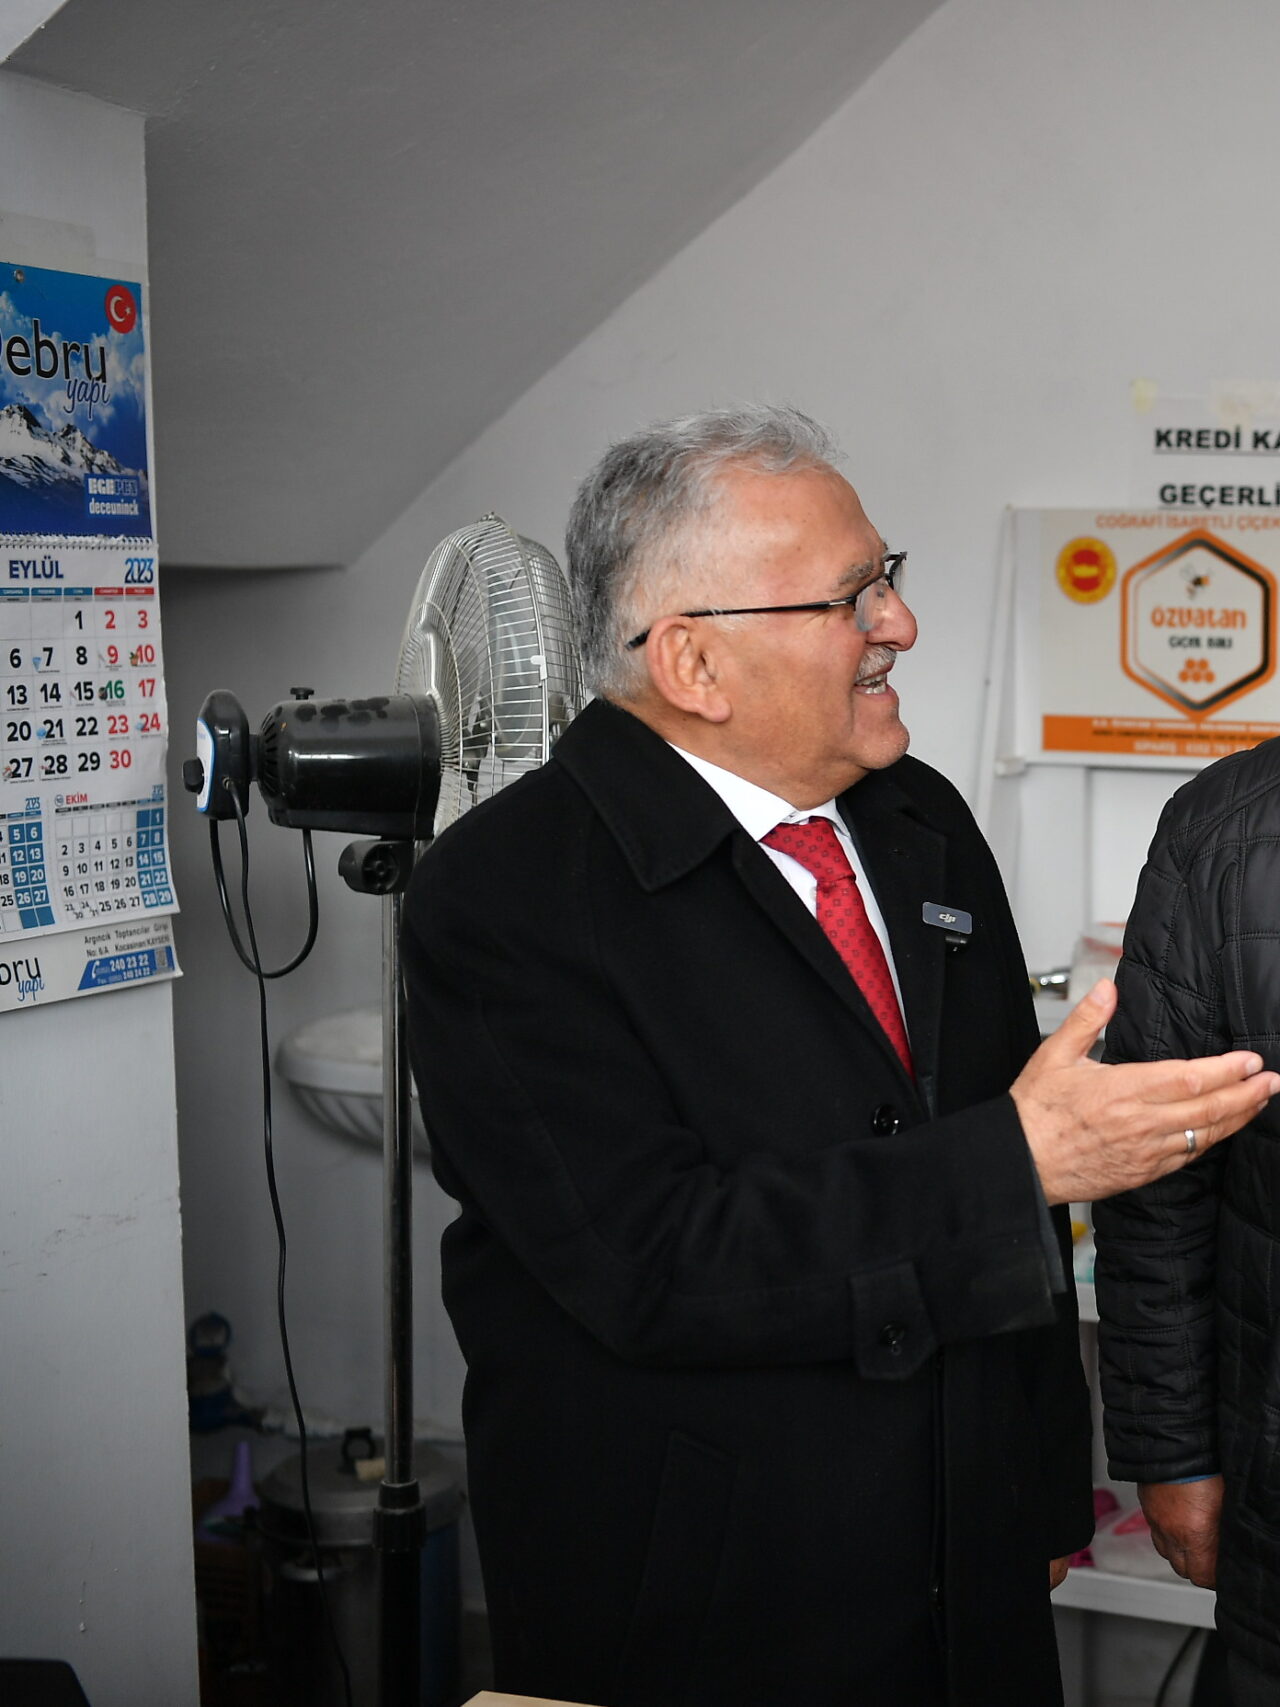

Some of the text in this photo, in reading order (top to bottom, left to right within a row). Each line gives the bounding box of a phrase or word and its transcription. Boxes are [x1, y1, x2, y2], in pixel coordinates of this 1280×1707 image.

[1155, 425, 1241, 449] KREDİ
[89, 497, 139, 515] deceuninck
[9, 556, 154, 583] EYLÜL 2023
[74, 610, 148, 630] 1 2 3
[9, 644, 155, 669] 6 7 8 9 10
[6, 678, 156, 706] 13 14 15 16 17
[6, 712, 161, 742] 20 21 22 23 24
[9, 750, 132, 779] 27 28 29 30
[65, 792, 88, 805] EKİM
[155, 812, 160, 823] 1
[13, 827, 38, 841] 5 6
[61, 844, 69, 856] 2
[78, 842, 86, 854] 3
[95, 840, 102, 851] 4
[111, 838, 118, 850] 5
[126, 836, 133, 848] 6
[140, 833, 147, 845] 7
[13, 852, 25, 864] 12
[29, 848, 41, 860] 13
[62, 865, 70, 877] 9
[77, 862, 88, 875] 10
[94, 860, 104, 872] 11
[110, 858, 121, 870] 12
[125, 856, 134, 868] 13
[138, 853, 150, 865] 14
[14, 873, 27, 883] 19
[30, 869, 44, 881] 20
[63, 871, 167, 898] 16 17 18 19 20 21 22
[1, 889, 47, 907] 25 26 27
[98, 900, 112, 913] 25
[114, 898, 127, 911] 26
[129, 896, 141, 908] 27
